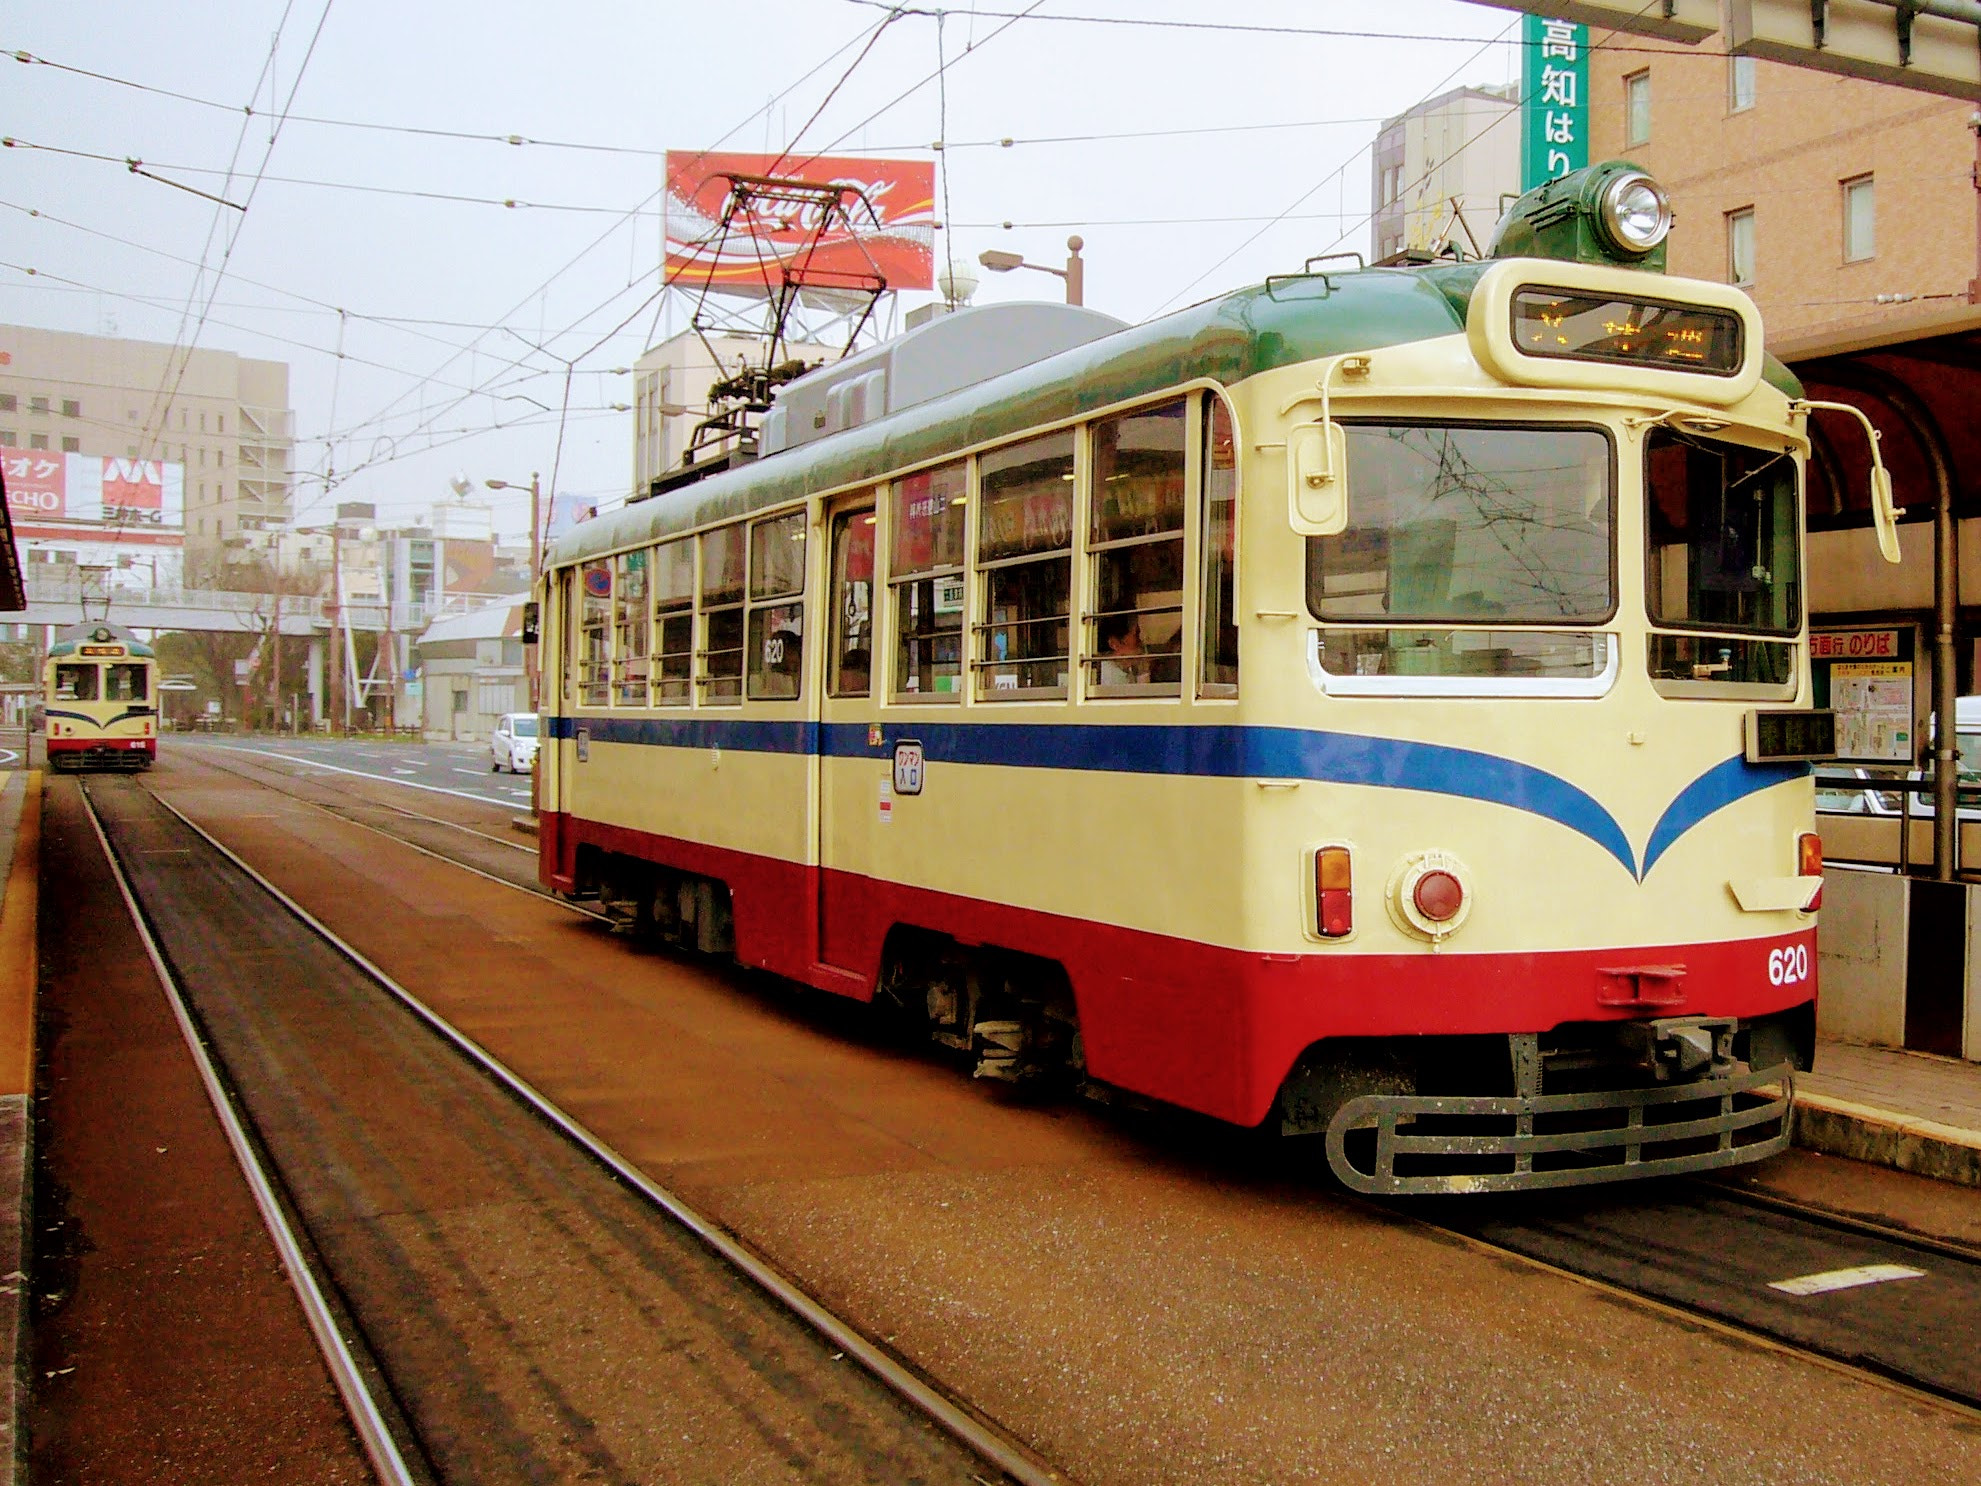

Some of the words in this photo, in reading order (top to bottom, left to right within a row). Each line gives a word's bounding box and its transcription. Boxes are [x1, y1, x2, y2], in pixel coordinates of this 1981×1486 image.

[1541, 18, 1578, 181] 高知はり
[765, 639, 784, 664] 620
[1849, 633, 1890, 655] のりば
[900, 768, 918, 785] 入口
[1769, 944, 1808, 986] 620
